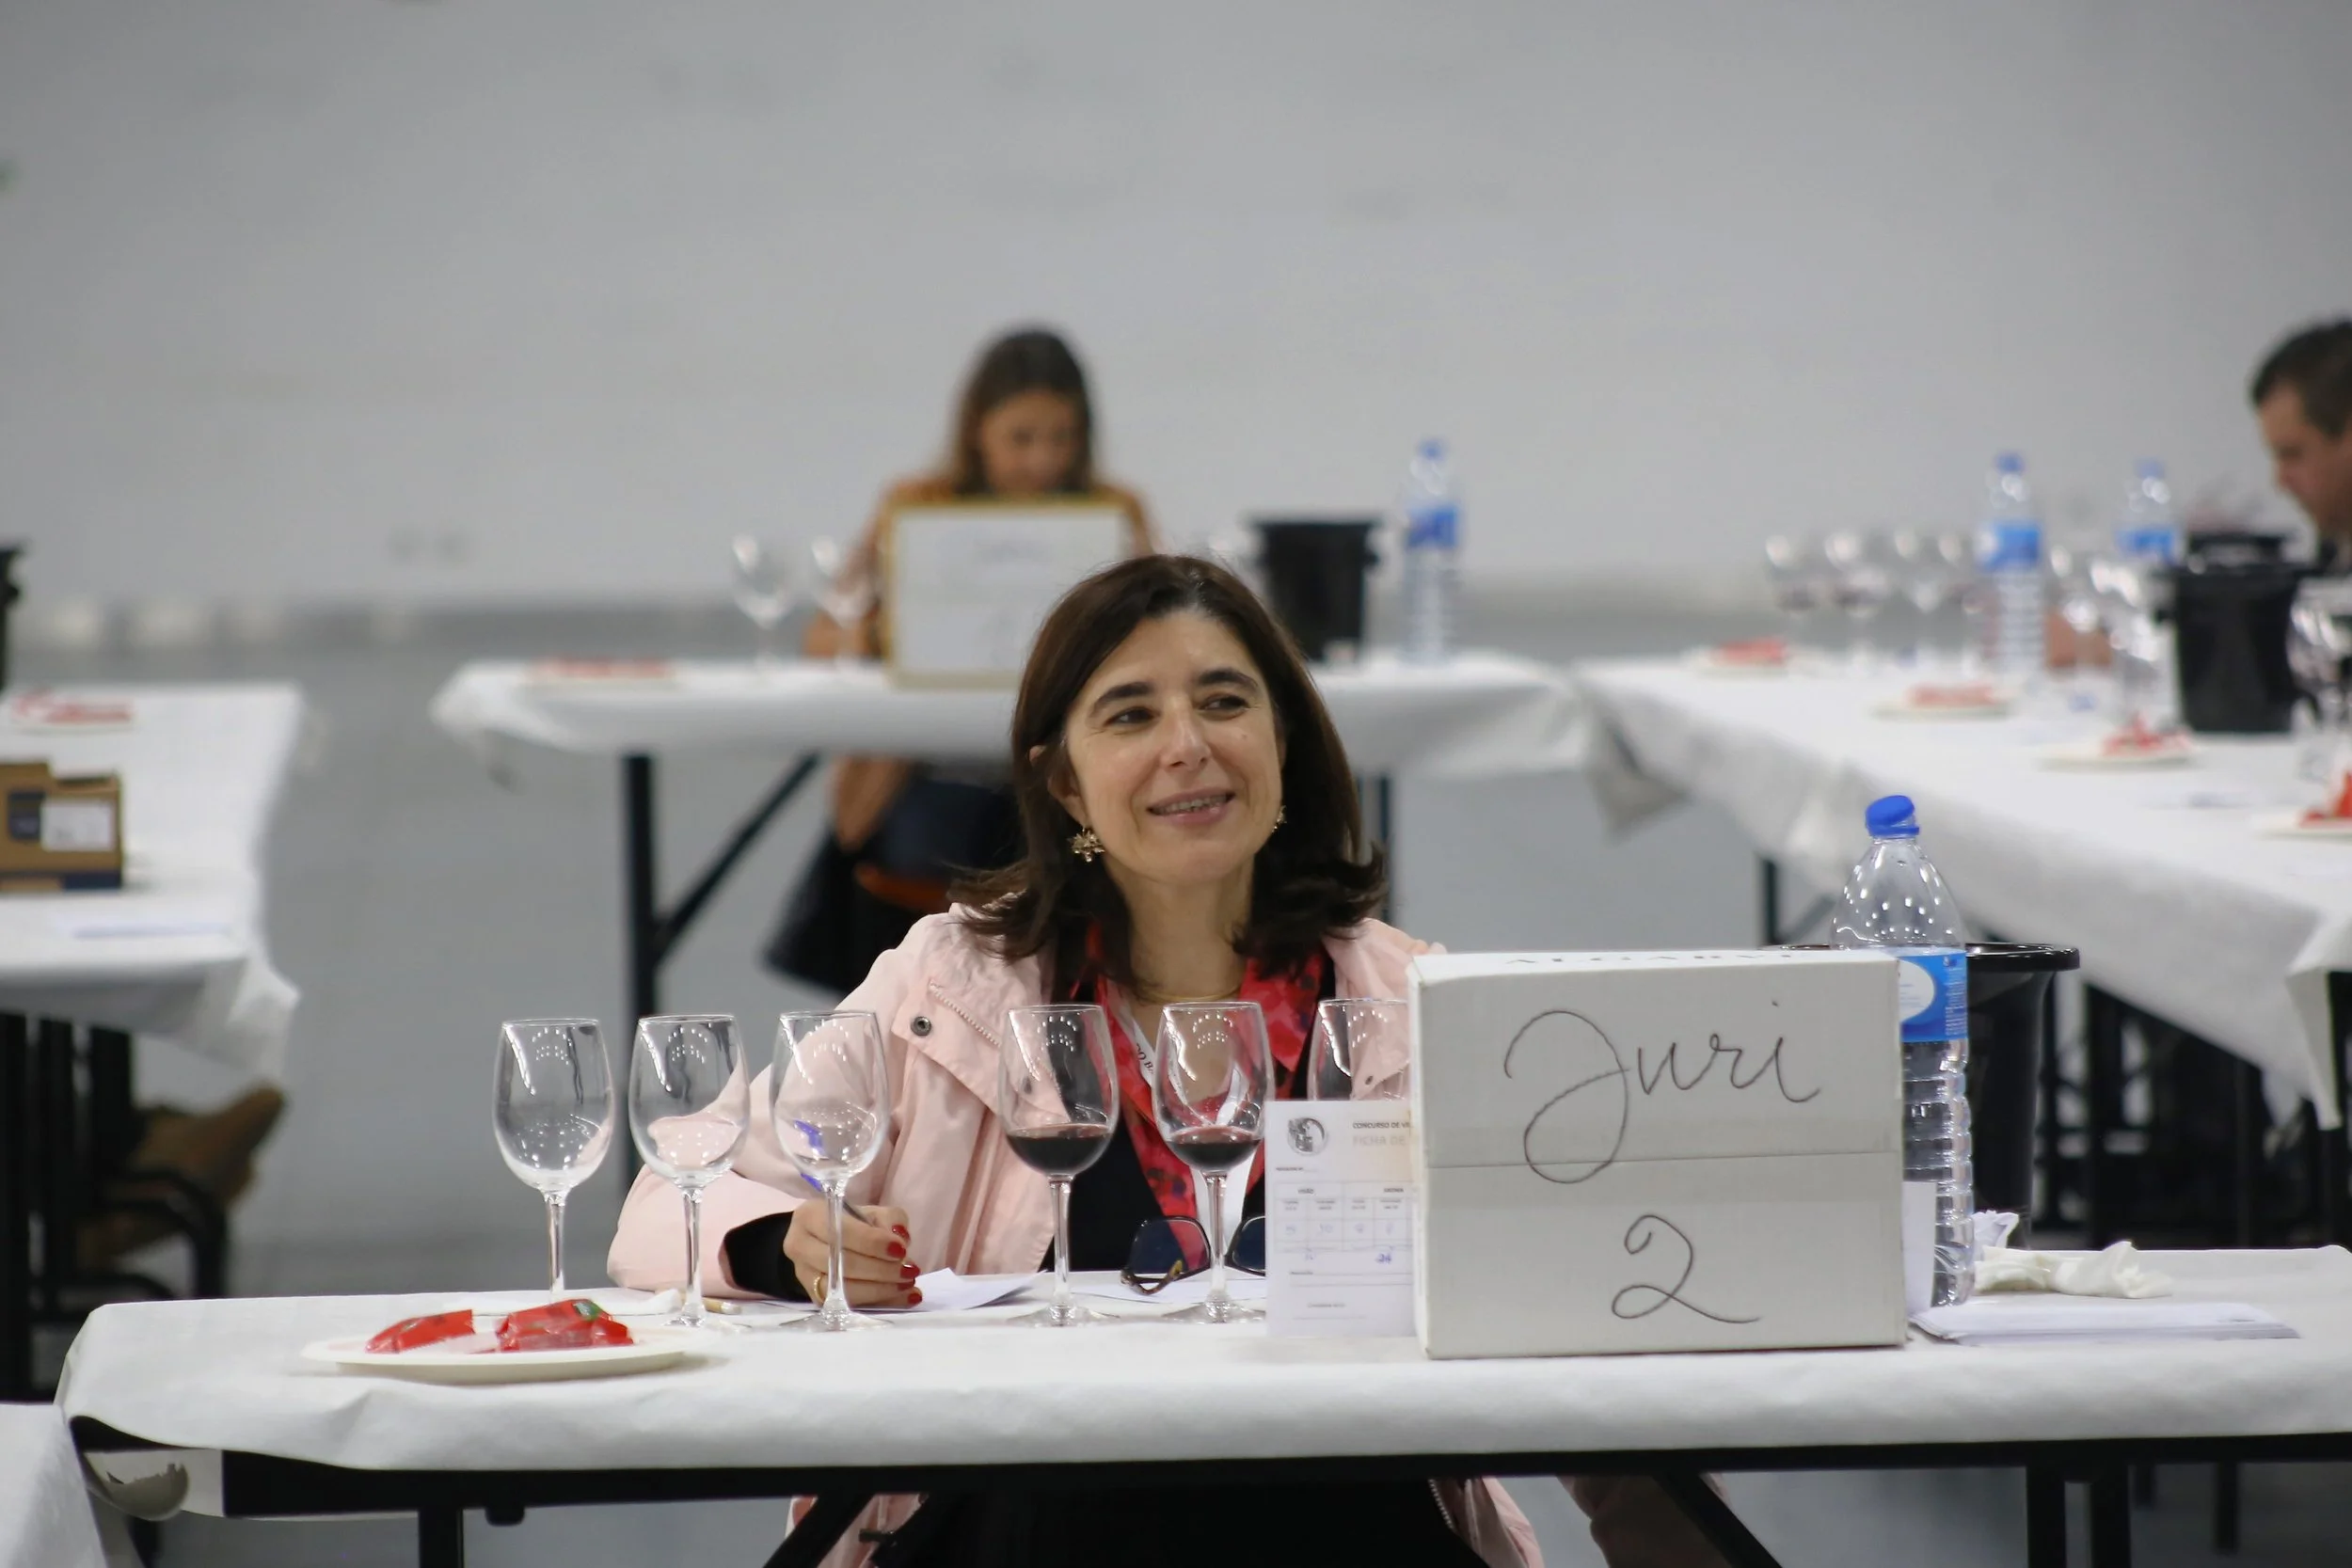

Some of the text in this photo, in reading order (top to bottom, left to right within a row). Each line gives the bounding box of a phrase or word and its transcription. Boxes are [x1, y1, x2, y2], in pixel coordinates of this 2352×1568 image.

[1503, 1000, 1821, 1184] Juri
[1352, 1121, 1390, 1130] CONCURSO
[1352, 1135, 1406, 1147] FICHA DE
[1612, 1214, 1763, 1324] 2
